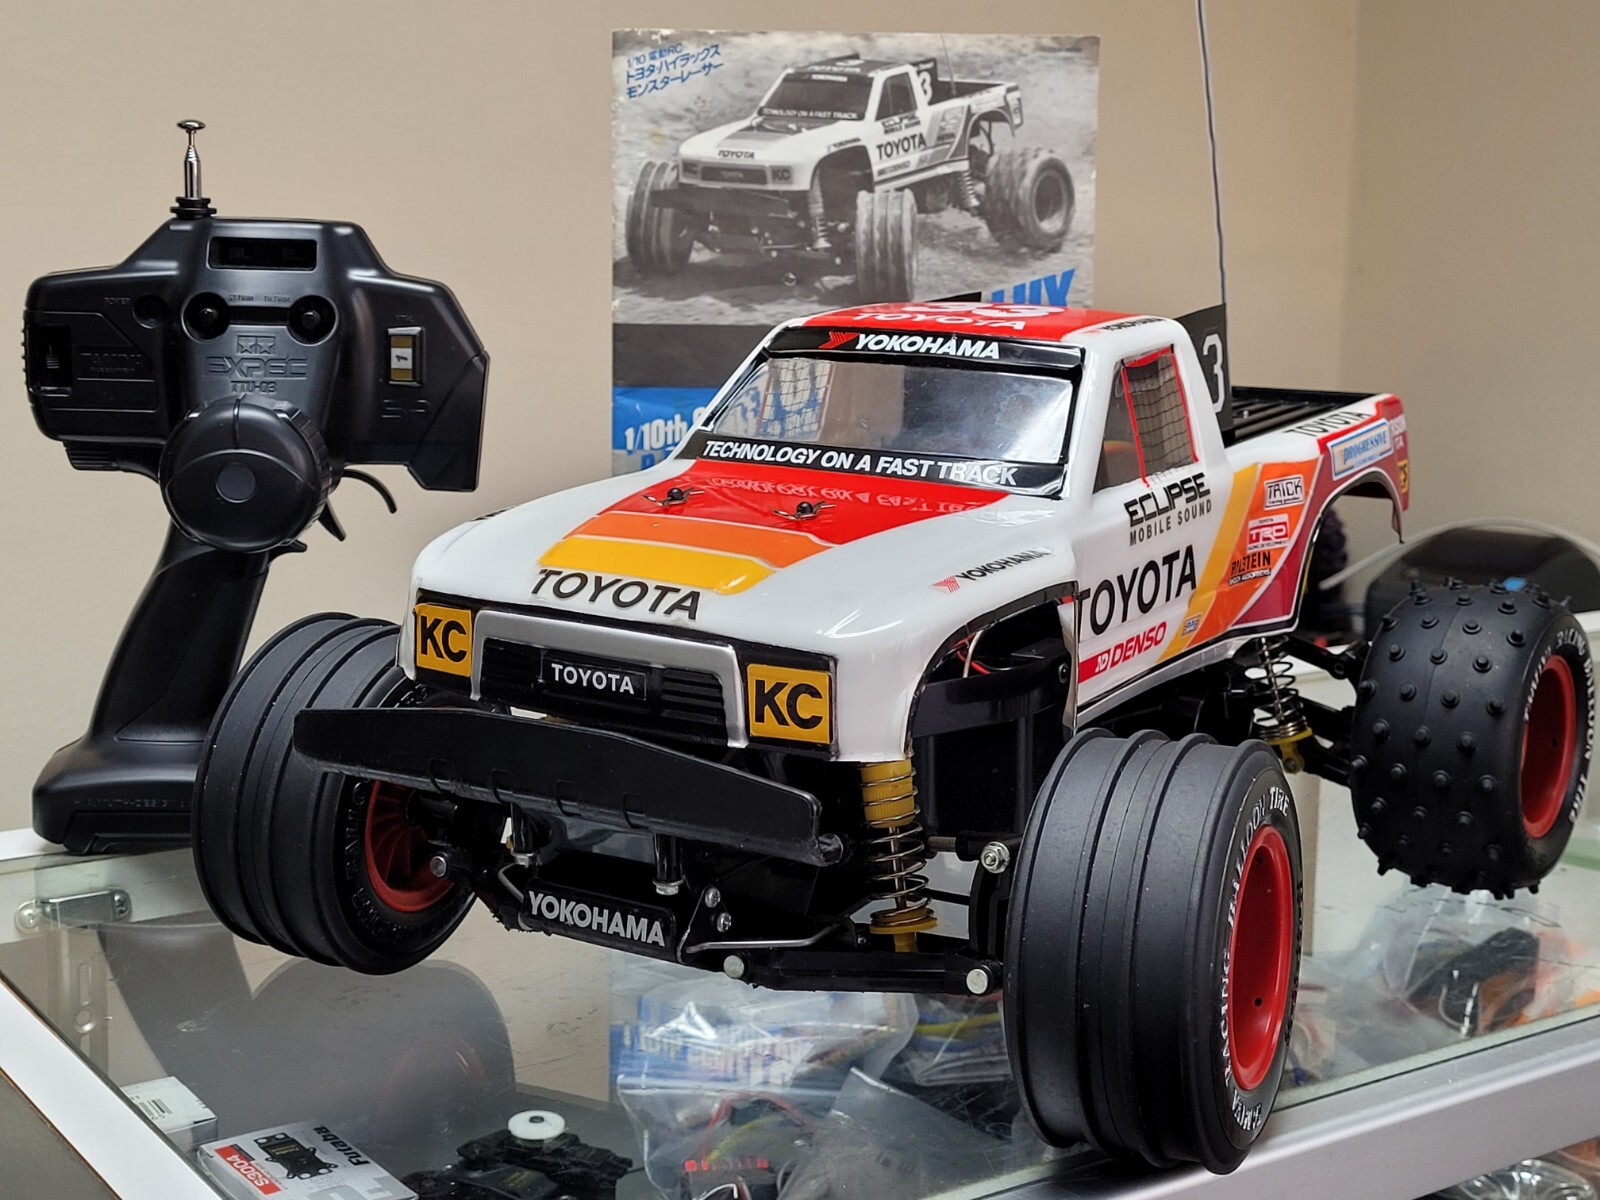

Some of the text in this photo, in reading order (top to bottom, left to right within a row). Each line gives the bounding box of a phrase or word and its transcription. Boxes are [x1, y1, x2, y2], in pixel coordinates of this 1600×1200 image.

[627, 63, 724, 98] モンスターレーサー
[718, 149, 755, 159] TOYOTA
[876, 133, 927, 160] TOYOTA
[852, 313, 1027, 331] TOYOTA
[854, 334, 1001, 360] YOKOHAMA
[1202, 333, 1226, 414] 3
[624, 413, 689, 452] 1/10th
[1282, 411, 1374, 438] TOYOTA
[703, 440, 1018, 486] TECHNOLOGY ON A FAST TRACK
[1124, 472, 1211, 527] ECLIPSE
[1267, 480, 1303, 500] TRICK
[1129, 498, 1212, 547] MOBILE SOUND
[1250, 524, 1287, 543] TRD
[955, 549, 1052, 581] YOKOHAMA
[531, 568, 701, 620] TOYOTA
[1078, 544, 1197, 643] TOYOTA
[420, 615, 467, 662] KC
[1110, 621, 1167, 668] DENSO
[551, 663, 635, 694] TOYOTA
[754, 679, 823, 730] KC
[1269, 782, 1290, 817] TIRE
[528, 890, 666, 947] YOKOHAMA
[313, 1126, 371, 1166] Futaba
[226, 1154, 270, 1187] S3004
